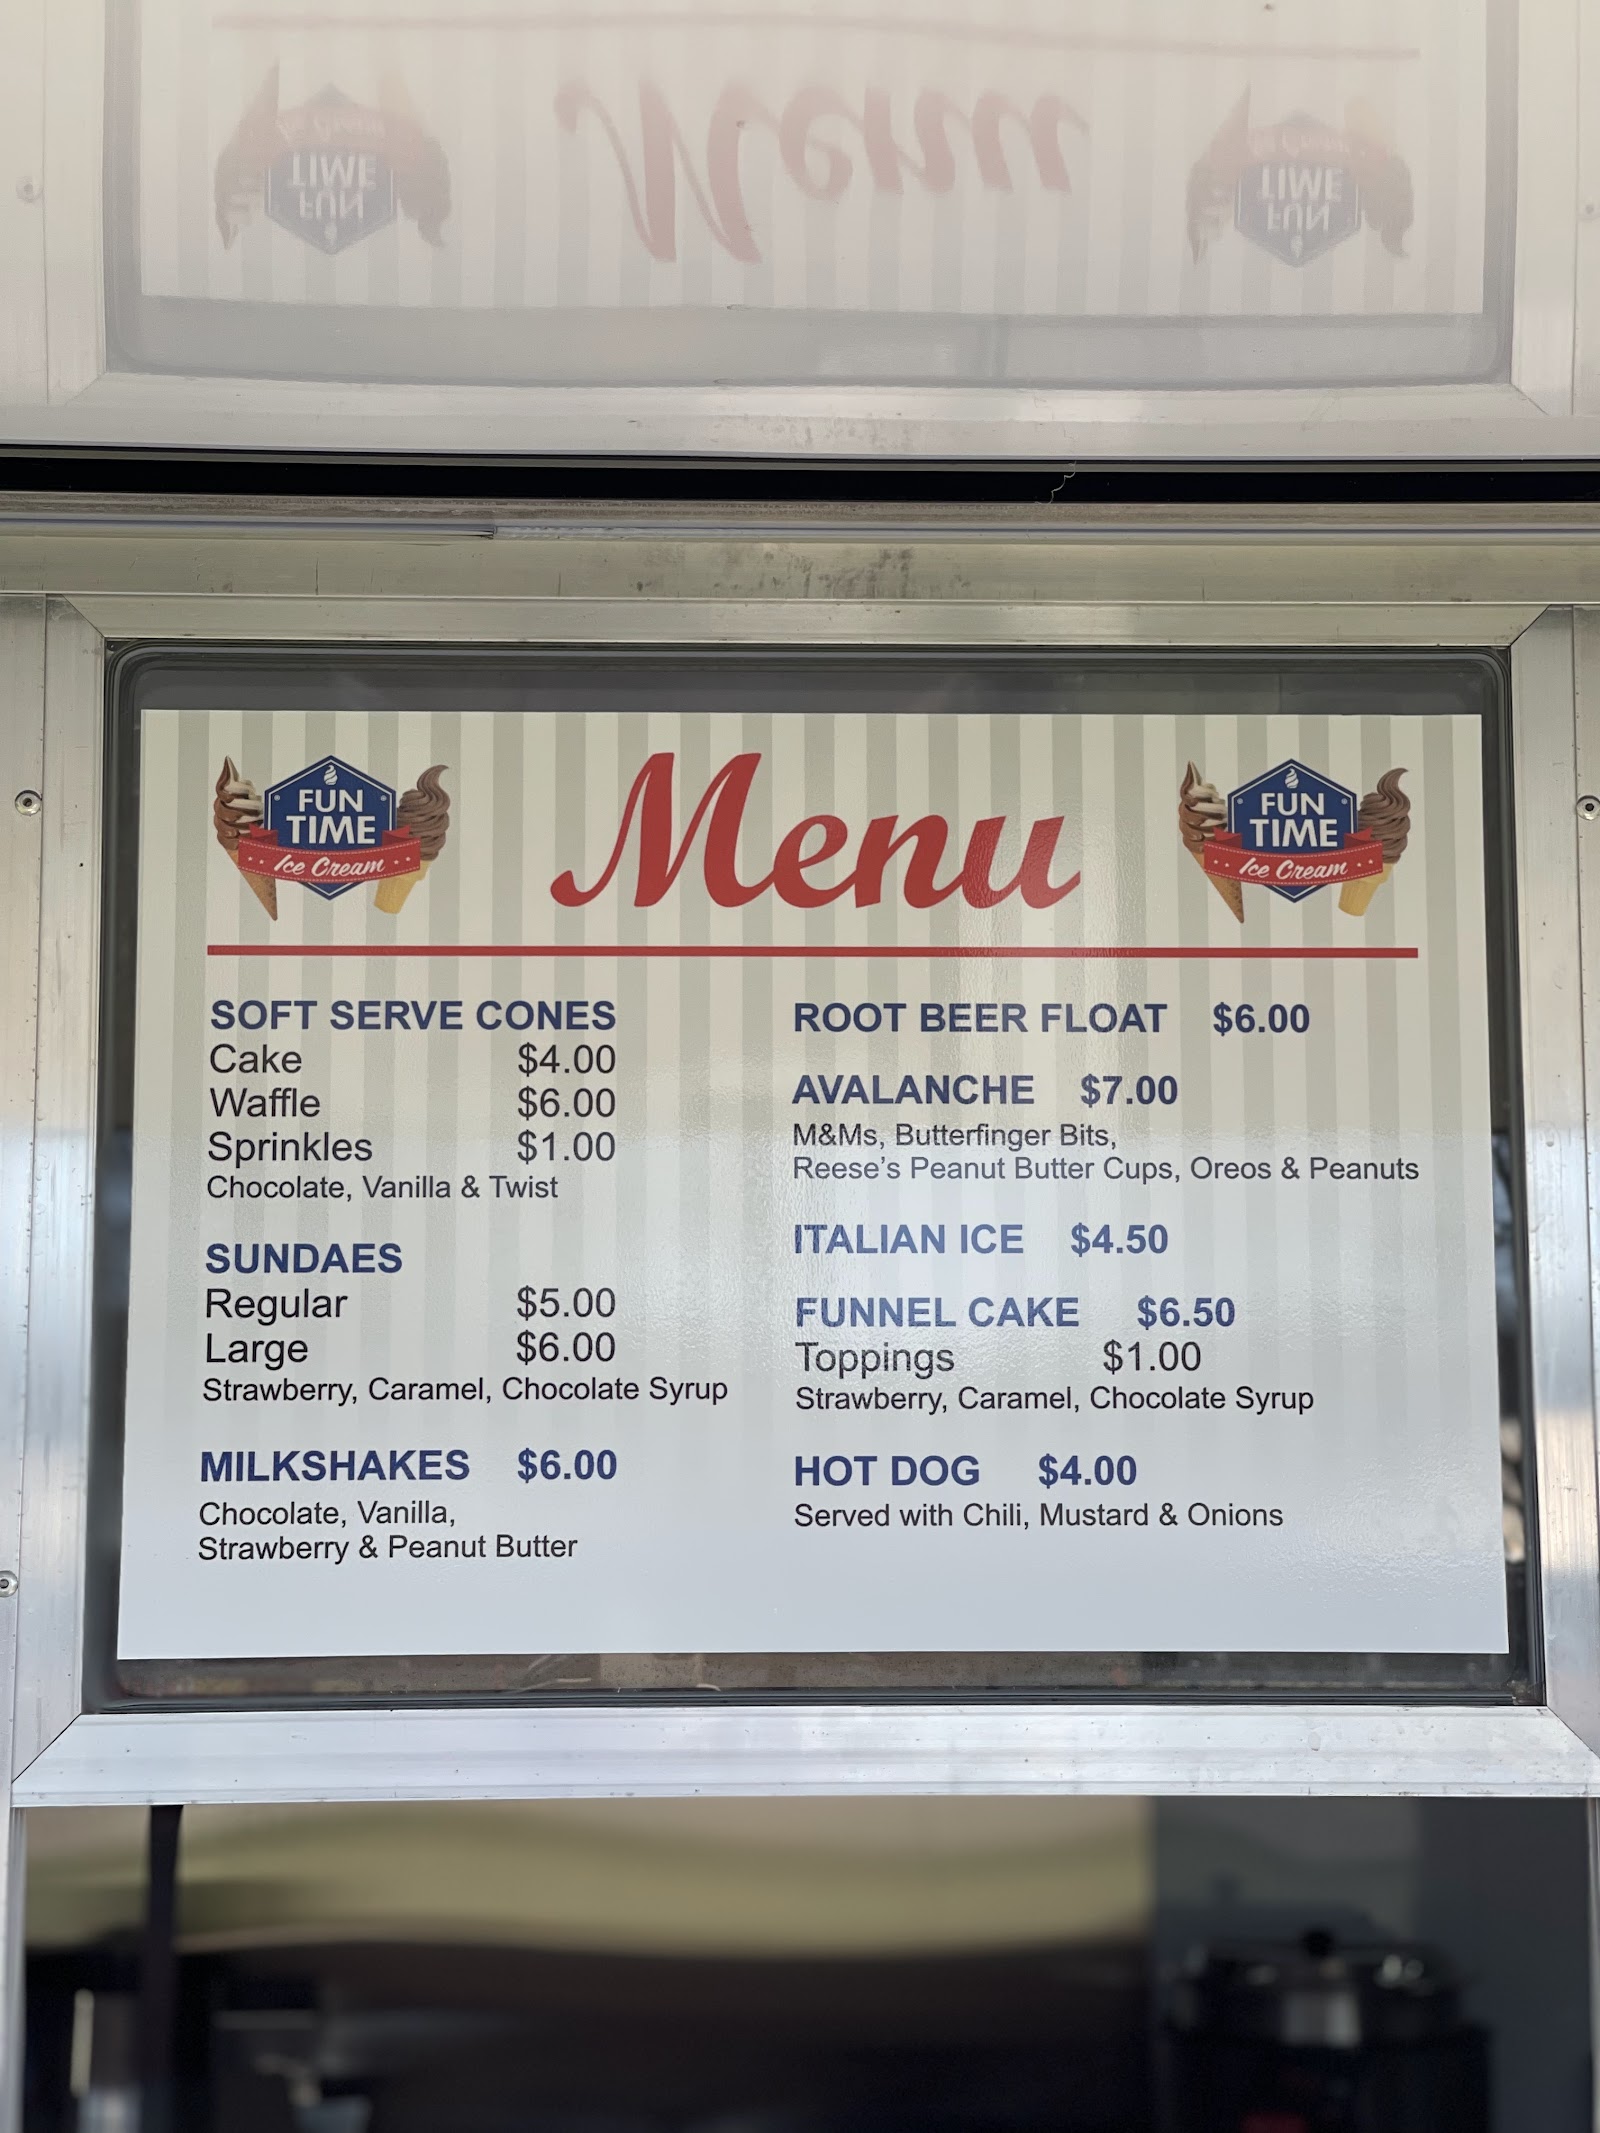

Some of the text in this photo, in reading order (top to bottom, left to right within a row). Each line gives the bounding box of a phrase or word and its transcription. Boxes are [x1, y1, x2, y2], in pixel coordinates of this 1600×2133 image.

[298, 789, 364, 813] FUN
[1261, 792, 1325, 816] FUN
[286, 815, 376, 845] TIME
[550, 752, 1081, 909] Menu
[1249, 818, 1338, 848] TIME
[273, 854, 385, 877] Ice Cream
[1238, 857, 1349, 880] Ice Cream
[211, 1000, 616, 1030] SOFT SERVE CONES
[794, 1002, 1310, 1037] ROOT BEER FLOAT $6.00
[210, 1042, 616, 1077] Cake $4.00
[209, 1085, 616, 1121] Waffle $6.00
[792, 1073, 1178, 1108] AVALANCHE $7.00
[208, 1129, 616, 1169] Sprinkles $1.00
[793, 1123, 1117, 1152] M&Ms, Butterfinger Bits,
[910, 1157, 1005, 1180] Peanut
[1014, 1157, 1095, 1180] Butter
[1103, 1156, 1180, 1185] Cups,
[1190, 1156, 1272, 1180] Oreos
[1281, 1156, 1301, 1180] &
[1310, 1157, 1420, 1180] Peanuts
[206, 1175, 558, 1202] Chocolate, Vanilla & Twist
[794, 1222, 1168, 1257] ITALIAN ICE $4.50
[205, 1243, 403, 1274] SUNDAES
[206, 1285, 616, 1326] Regular $5.00
[796, 1295, 1236, 1330] FUNNEL CAKE $6.50
[206, 1329, 616, 1371] Large $6.00
[795, 1339, 1202, 1380] Toppings $1.00
[202, 1376, 729, 1407] Strawberry, Caramel, Chocolate Syrup
[795, 1386, 1315, 1415] Strawberry, Caramel, Chocolate Syrup
[200, 1448, 618, 1484] MILKSHAKES $6.00
[795, 1453, 1137, 1489] HOT DOG $4.00
[200, 1500, 455, 1528] Chocolate, Vanilla,
[794, 1503, 1284, 1530] Served with Chili, Mustard & Onions
[199, 1534, 578, 1565] Strawberry & Peanut Butter
